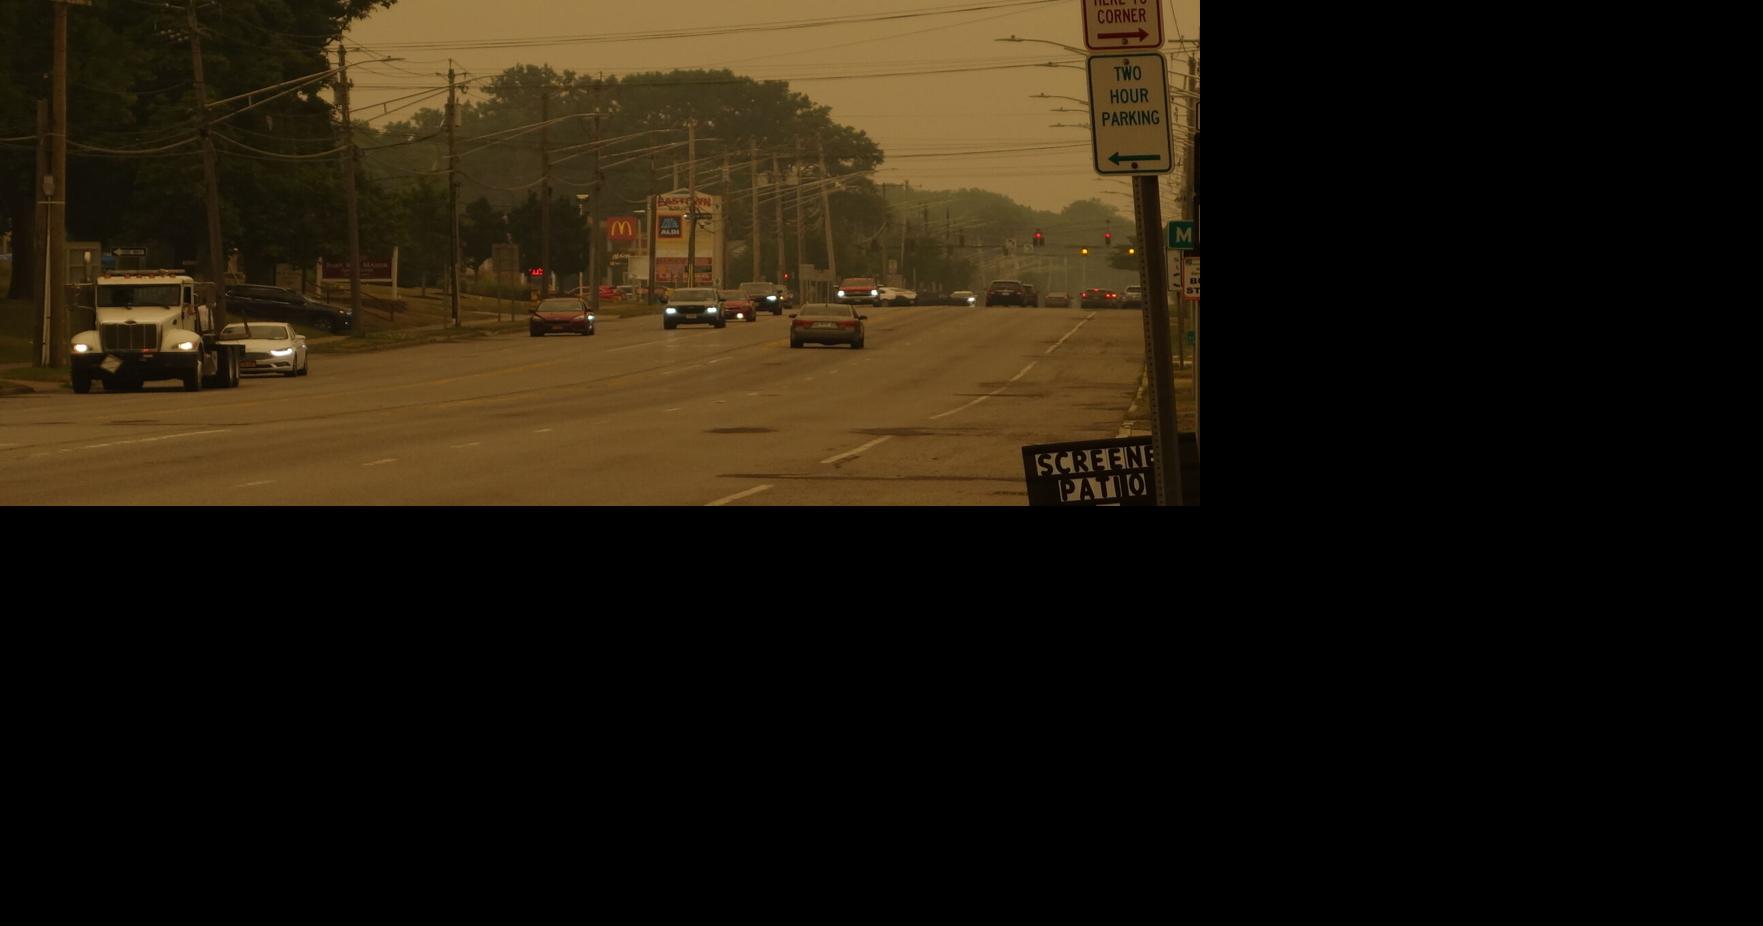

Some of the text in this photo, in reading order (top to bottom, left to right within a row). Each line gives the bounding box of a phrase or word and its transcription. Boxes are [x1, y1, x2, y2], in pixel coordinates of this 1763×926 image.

[1097, 8, 1146, 24] CORNER
[1114, 65, 1142, 81] TWO
[1110, 88, 1149, 104] HOUR
[1102, 110, 1160, 127] PARKING
[658, 196, 712, 207] EASTWN
[1060, 472, 1145, 502] PATIO
